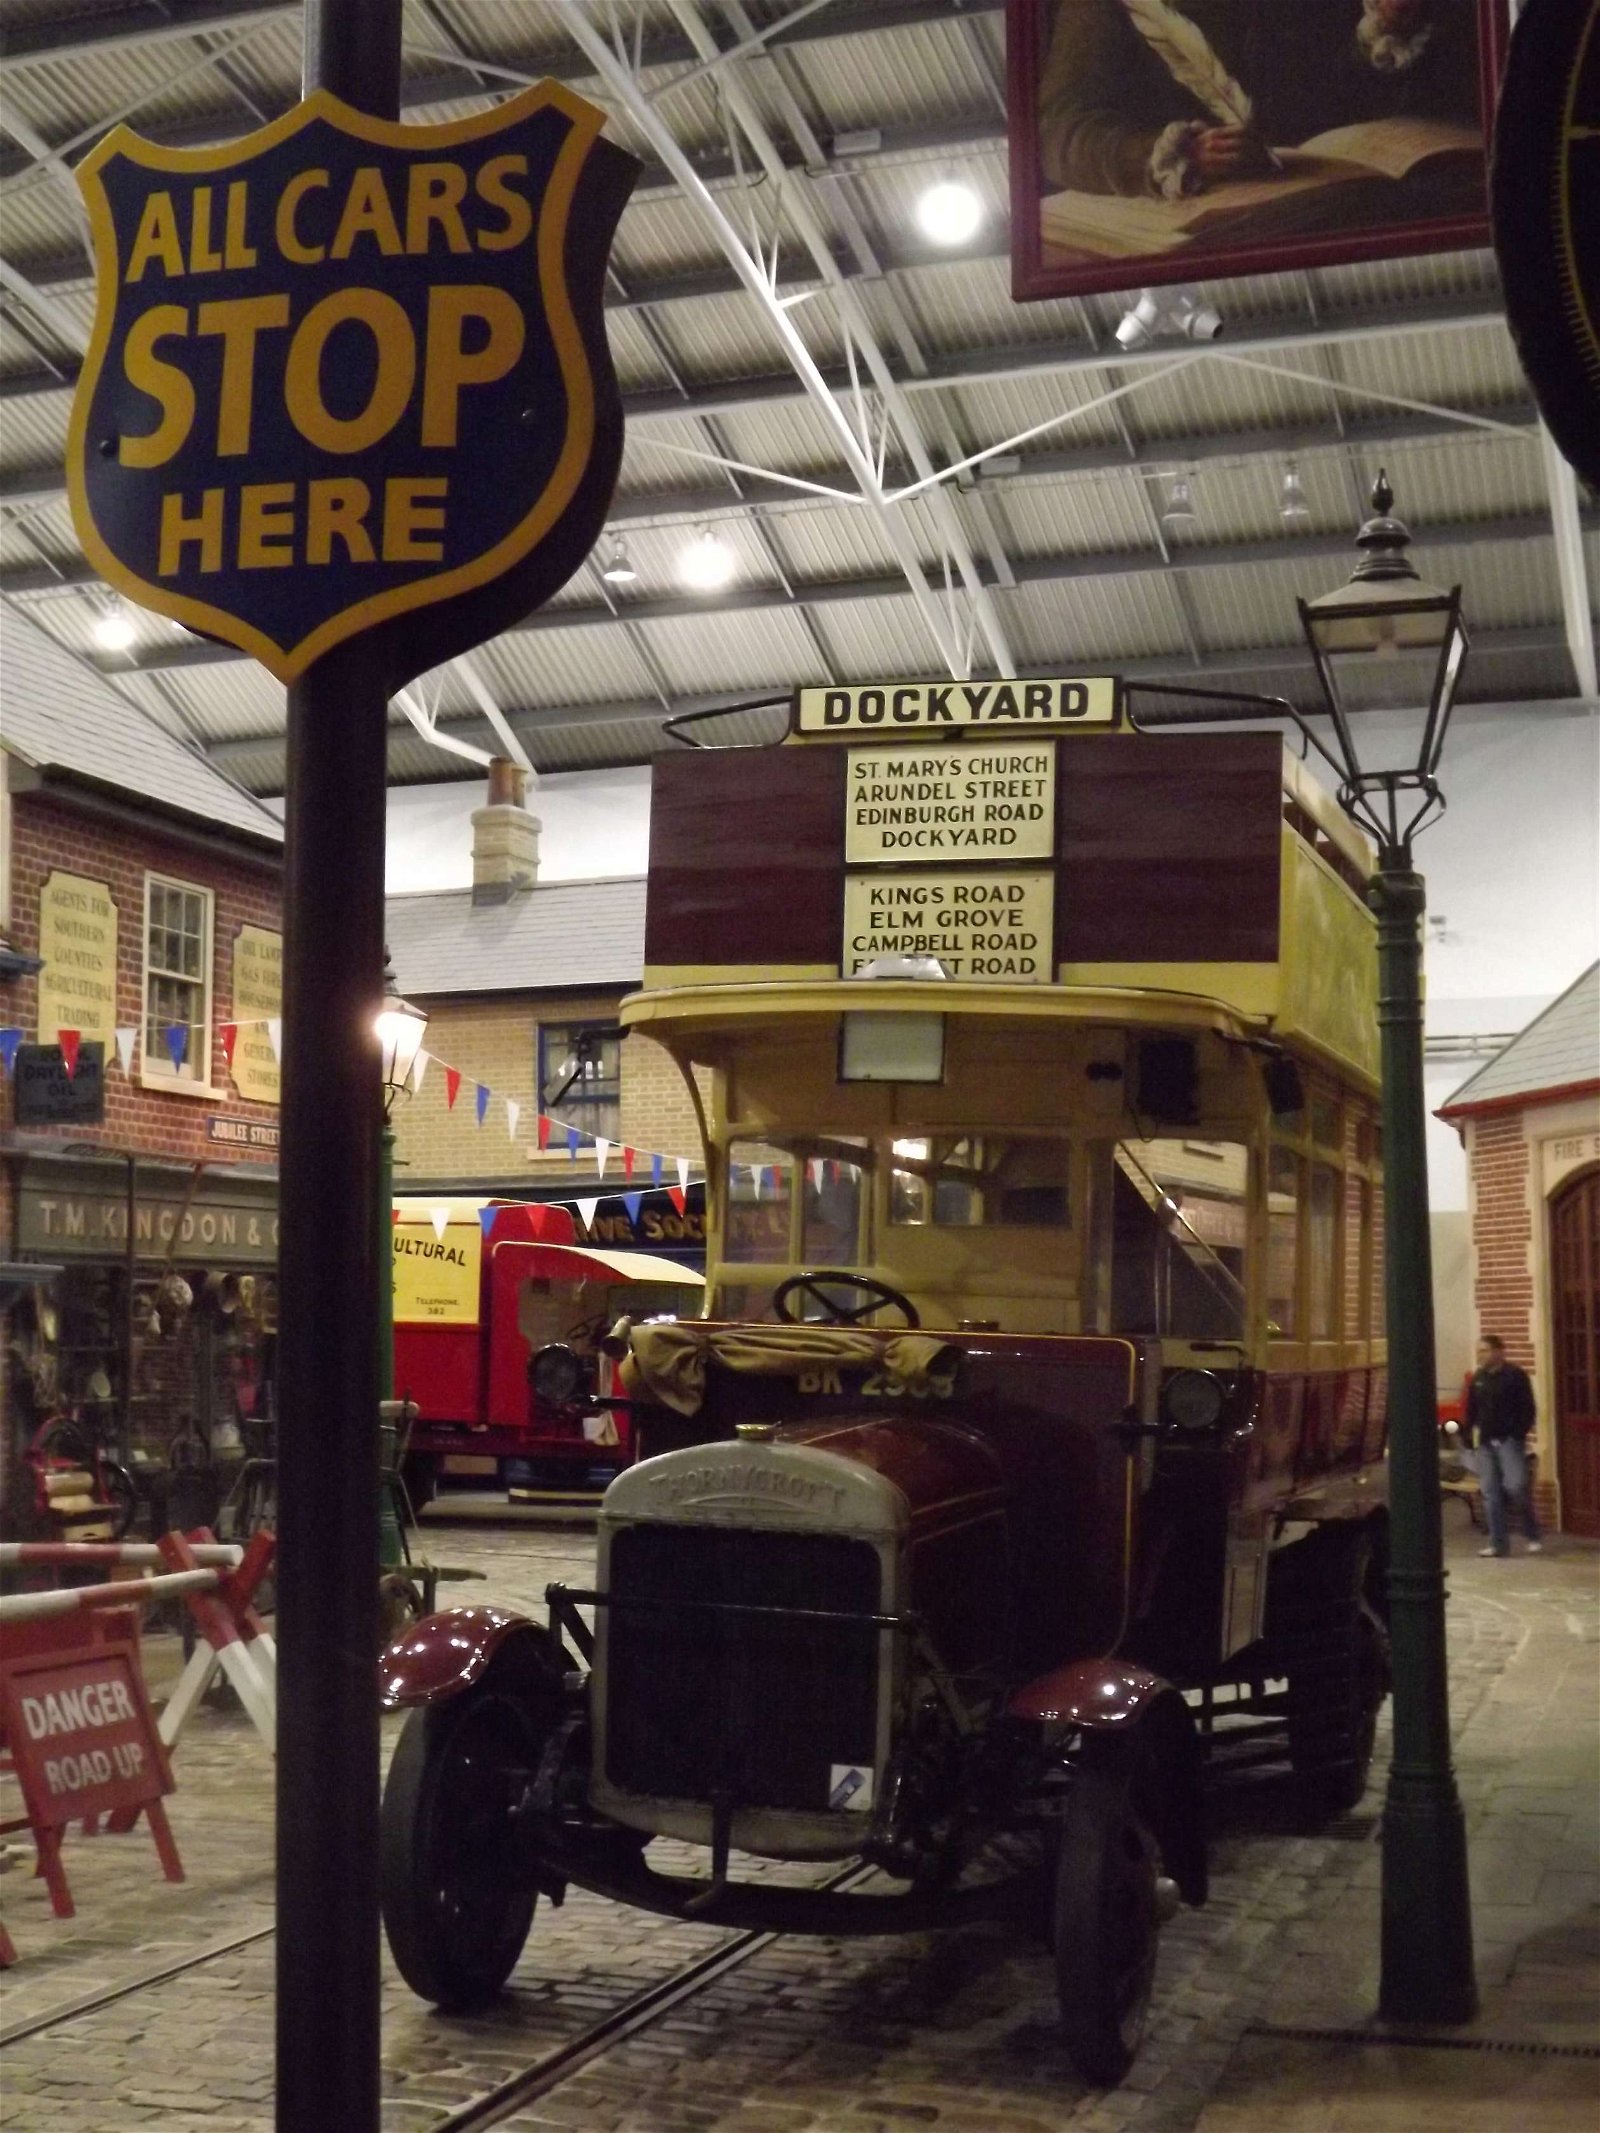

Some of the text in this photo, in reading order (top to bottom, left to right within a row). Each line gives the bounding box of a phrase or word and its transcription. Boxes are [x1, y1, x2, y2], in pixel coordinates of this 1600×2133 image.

[126, 154, 533, 283] ALL CARS
[118, 285, 526, 469] STOP
[157, 476, 449, 577] HERE
[824, 682, 1089, 726] DOCKYARD
[968, 756, 1048, 775] CHURCH
[854, 779, 1047, 803] ARUNDEL STREET
[856, 803, 1044, 825] EDINBURGH ROAD
[881, 827, 1017, 848] DOCKYARD
[870, 885, 1025, 905] KINGS ROAD
[870, 909, 1024, 929] ELM GROVE
[852, 933, 1037, 952] CAMPBELL ROAD
[971, 957, 1036, 975] ROAD
[211, 1120, 248, 1141] JUBILEE
[393, 1237, 466, 1267] ULTURAL
[22, 1681, 136, 1739] DANGER
[44, 1742, 144, 1794] ROAD UP
